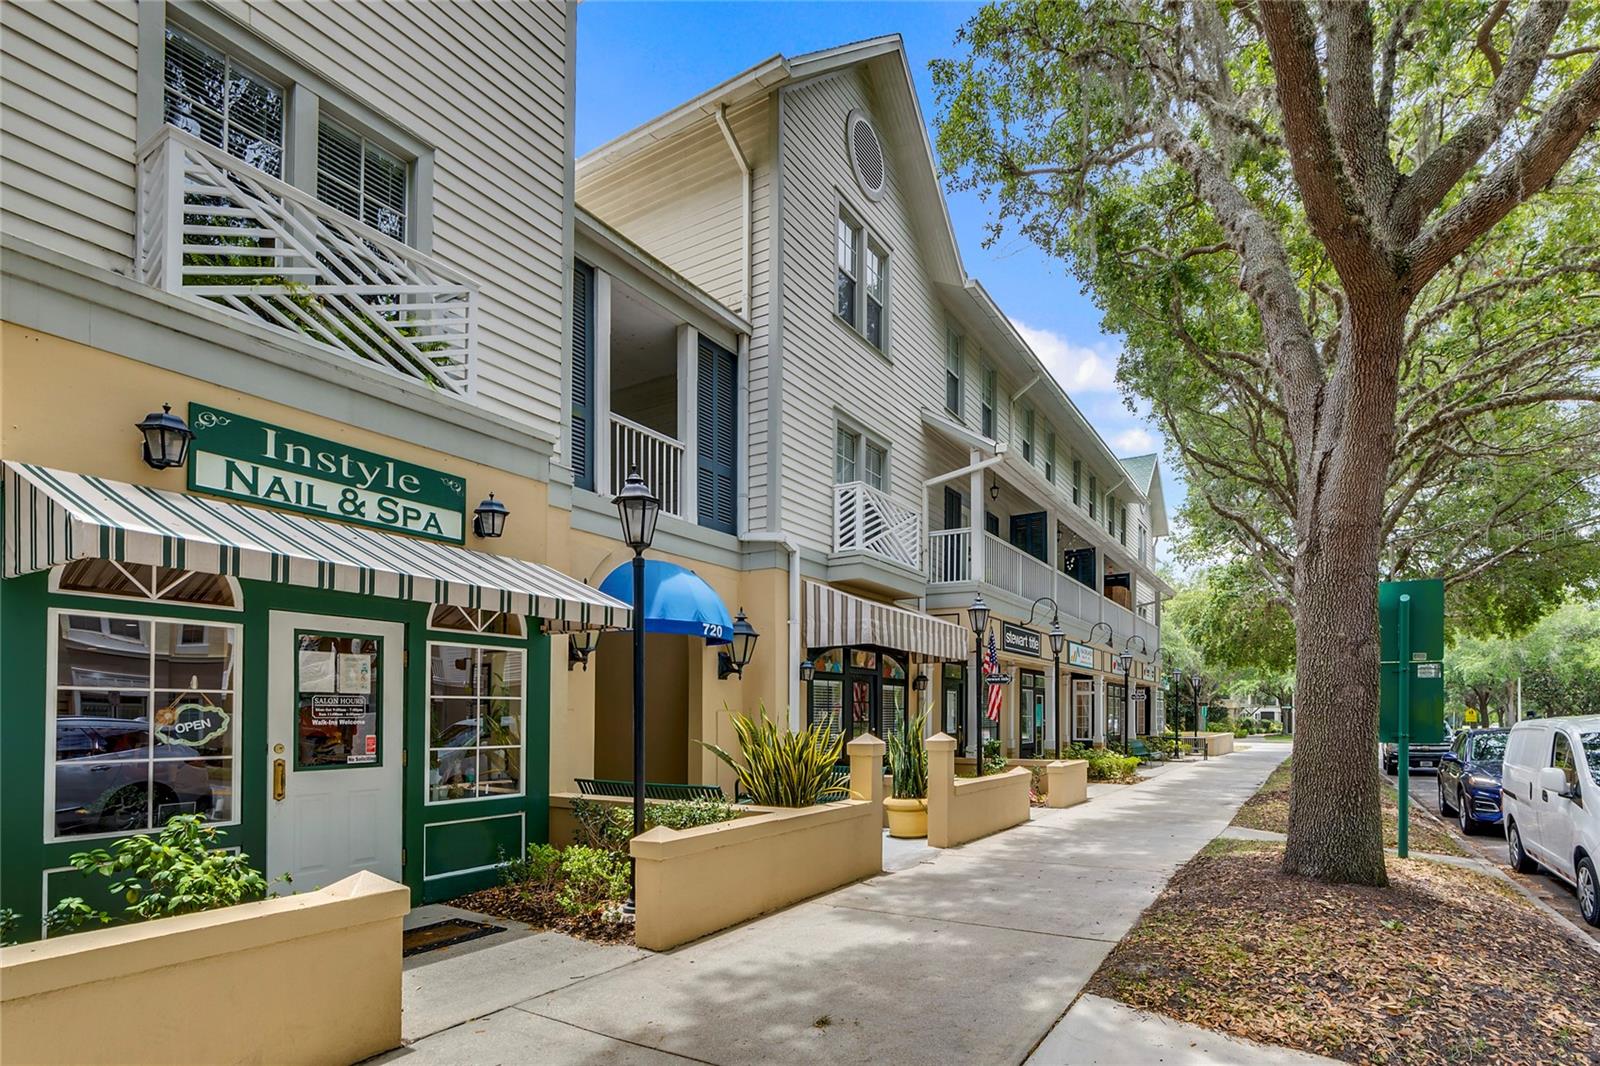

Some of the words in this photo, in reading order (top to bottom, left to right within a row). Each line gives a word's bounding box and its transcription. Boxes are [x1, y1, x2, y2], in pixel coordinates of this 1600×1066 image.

[262, 427, 421, 494] Instyle
[225, 460, 328, 512] NAIL
[338, 487, 366, 518] &
[377, 496, 445, 535] SPA
[703, 623, 722, 637] 720
[1005, 631, 1028, 648] stewart
[175, 718, 211, 733] OPEN
